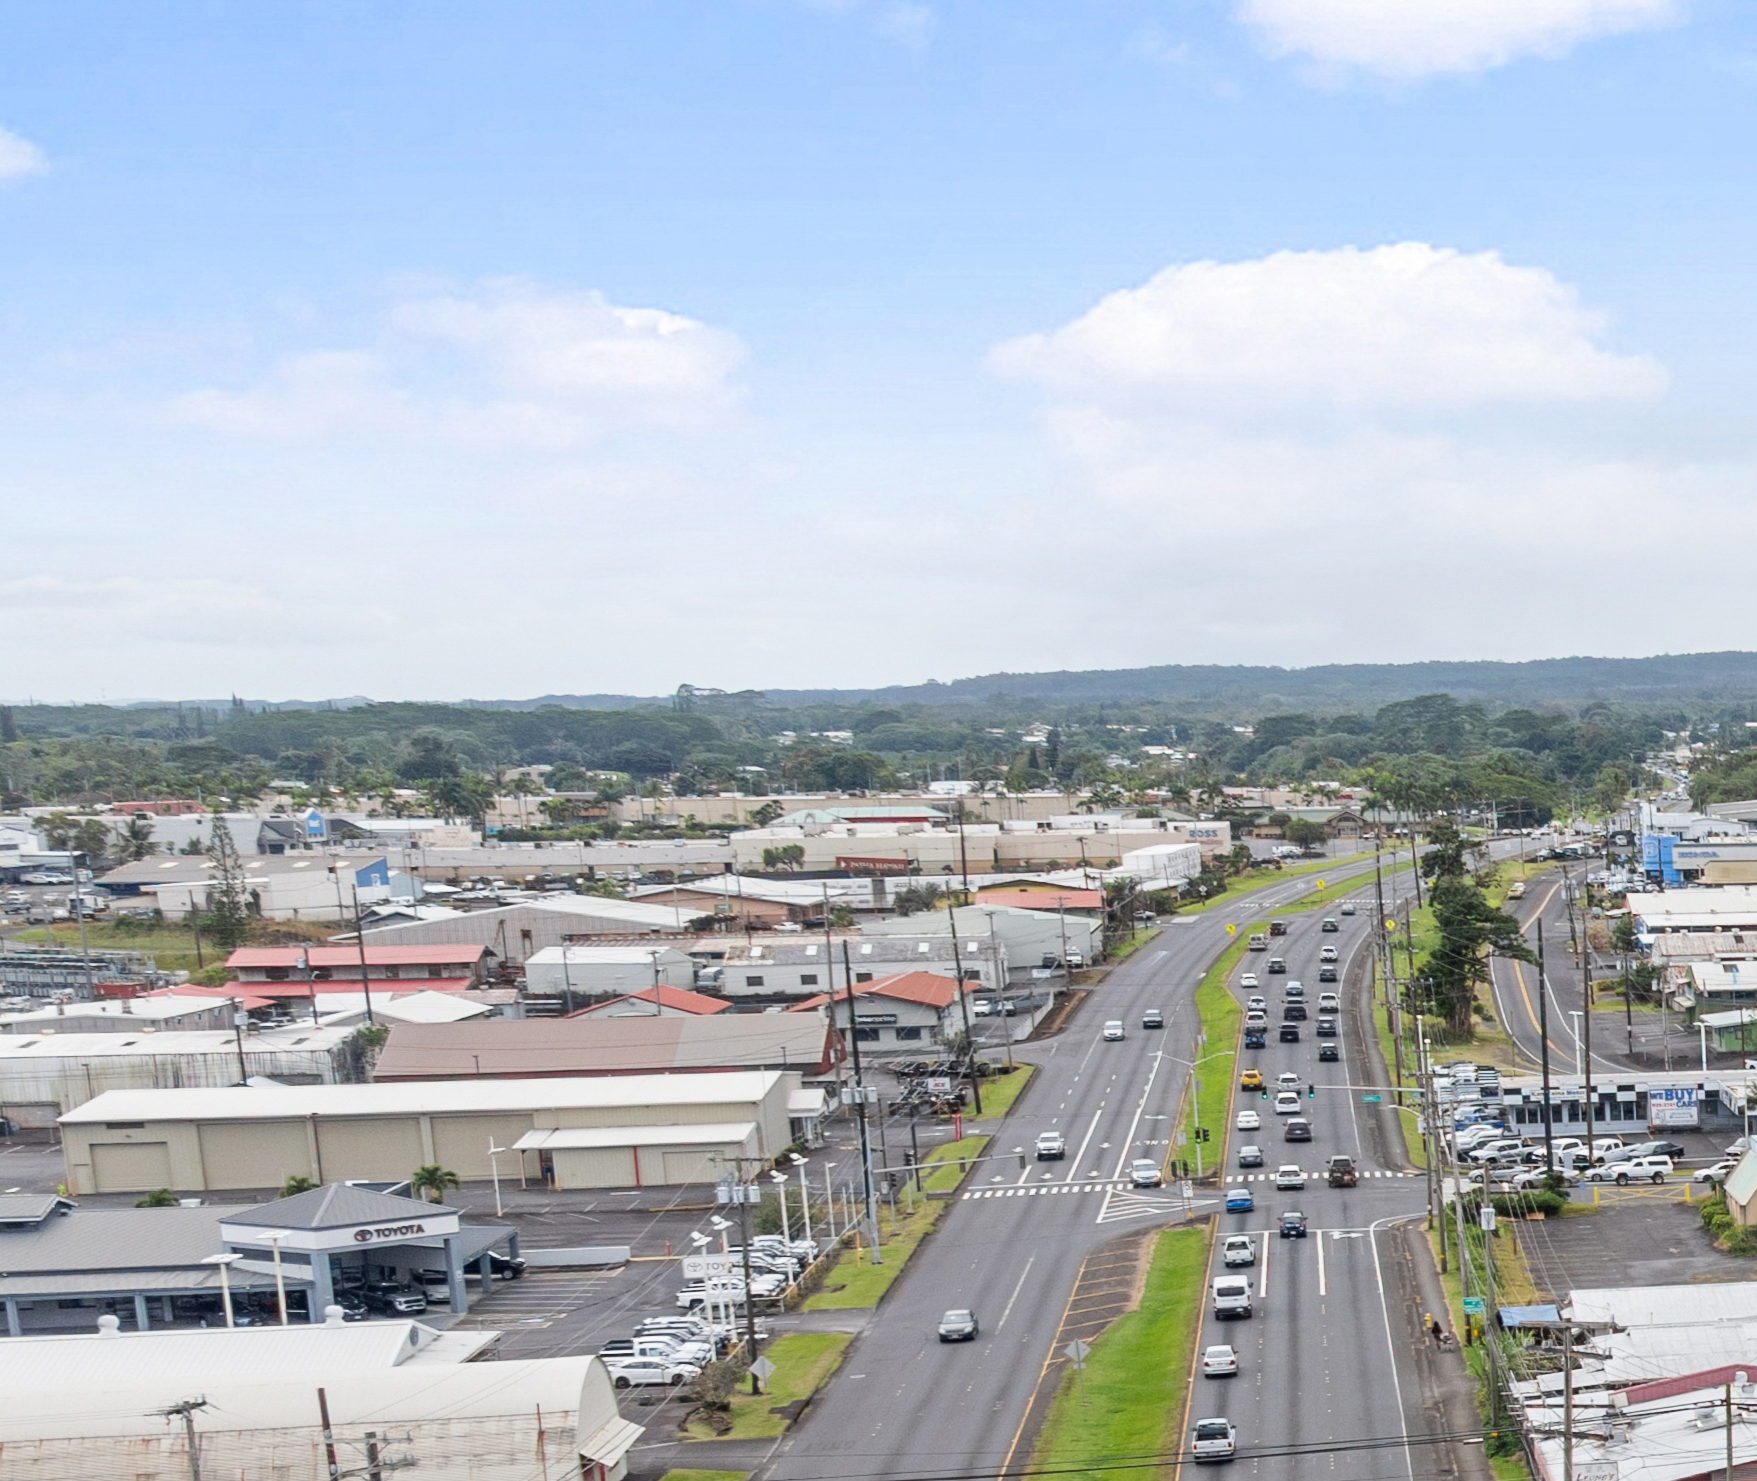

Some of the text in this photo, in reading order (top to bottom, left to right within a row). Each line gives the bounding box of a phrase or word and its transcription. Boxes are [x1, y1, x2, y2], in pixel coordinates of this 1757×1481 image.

[1189, 829, 1219, 838] ROSS
[1665, 1089, 1695, 1101] BUY
[1132, 1139, 1169, 1147] ONLY
[374, 1224, 425, 1239] TOYOTA
